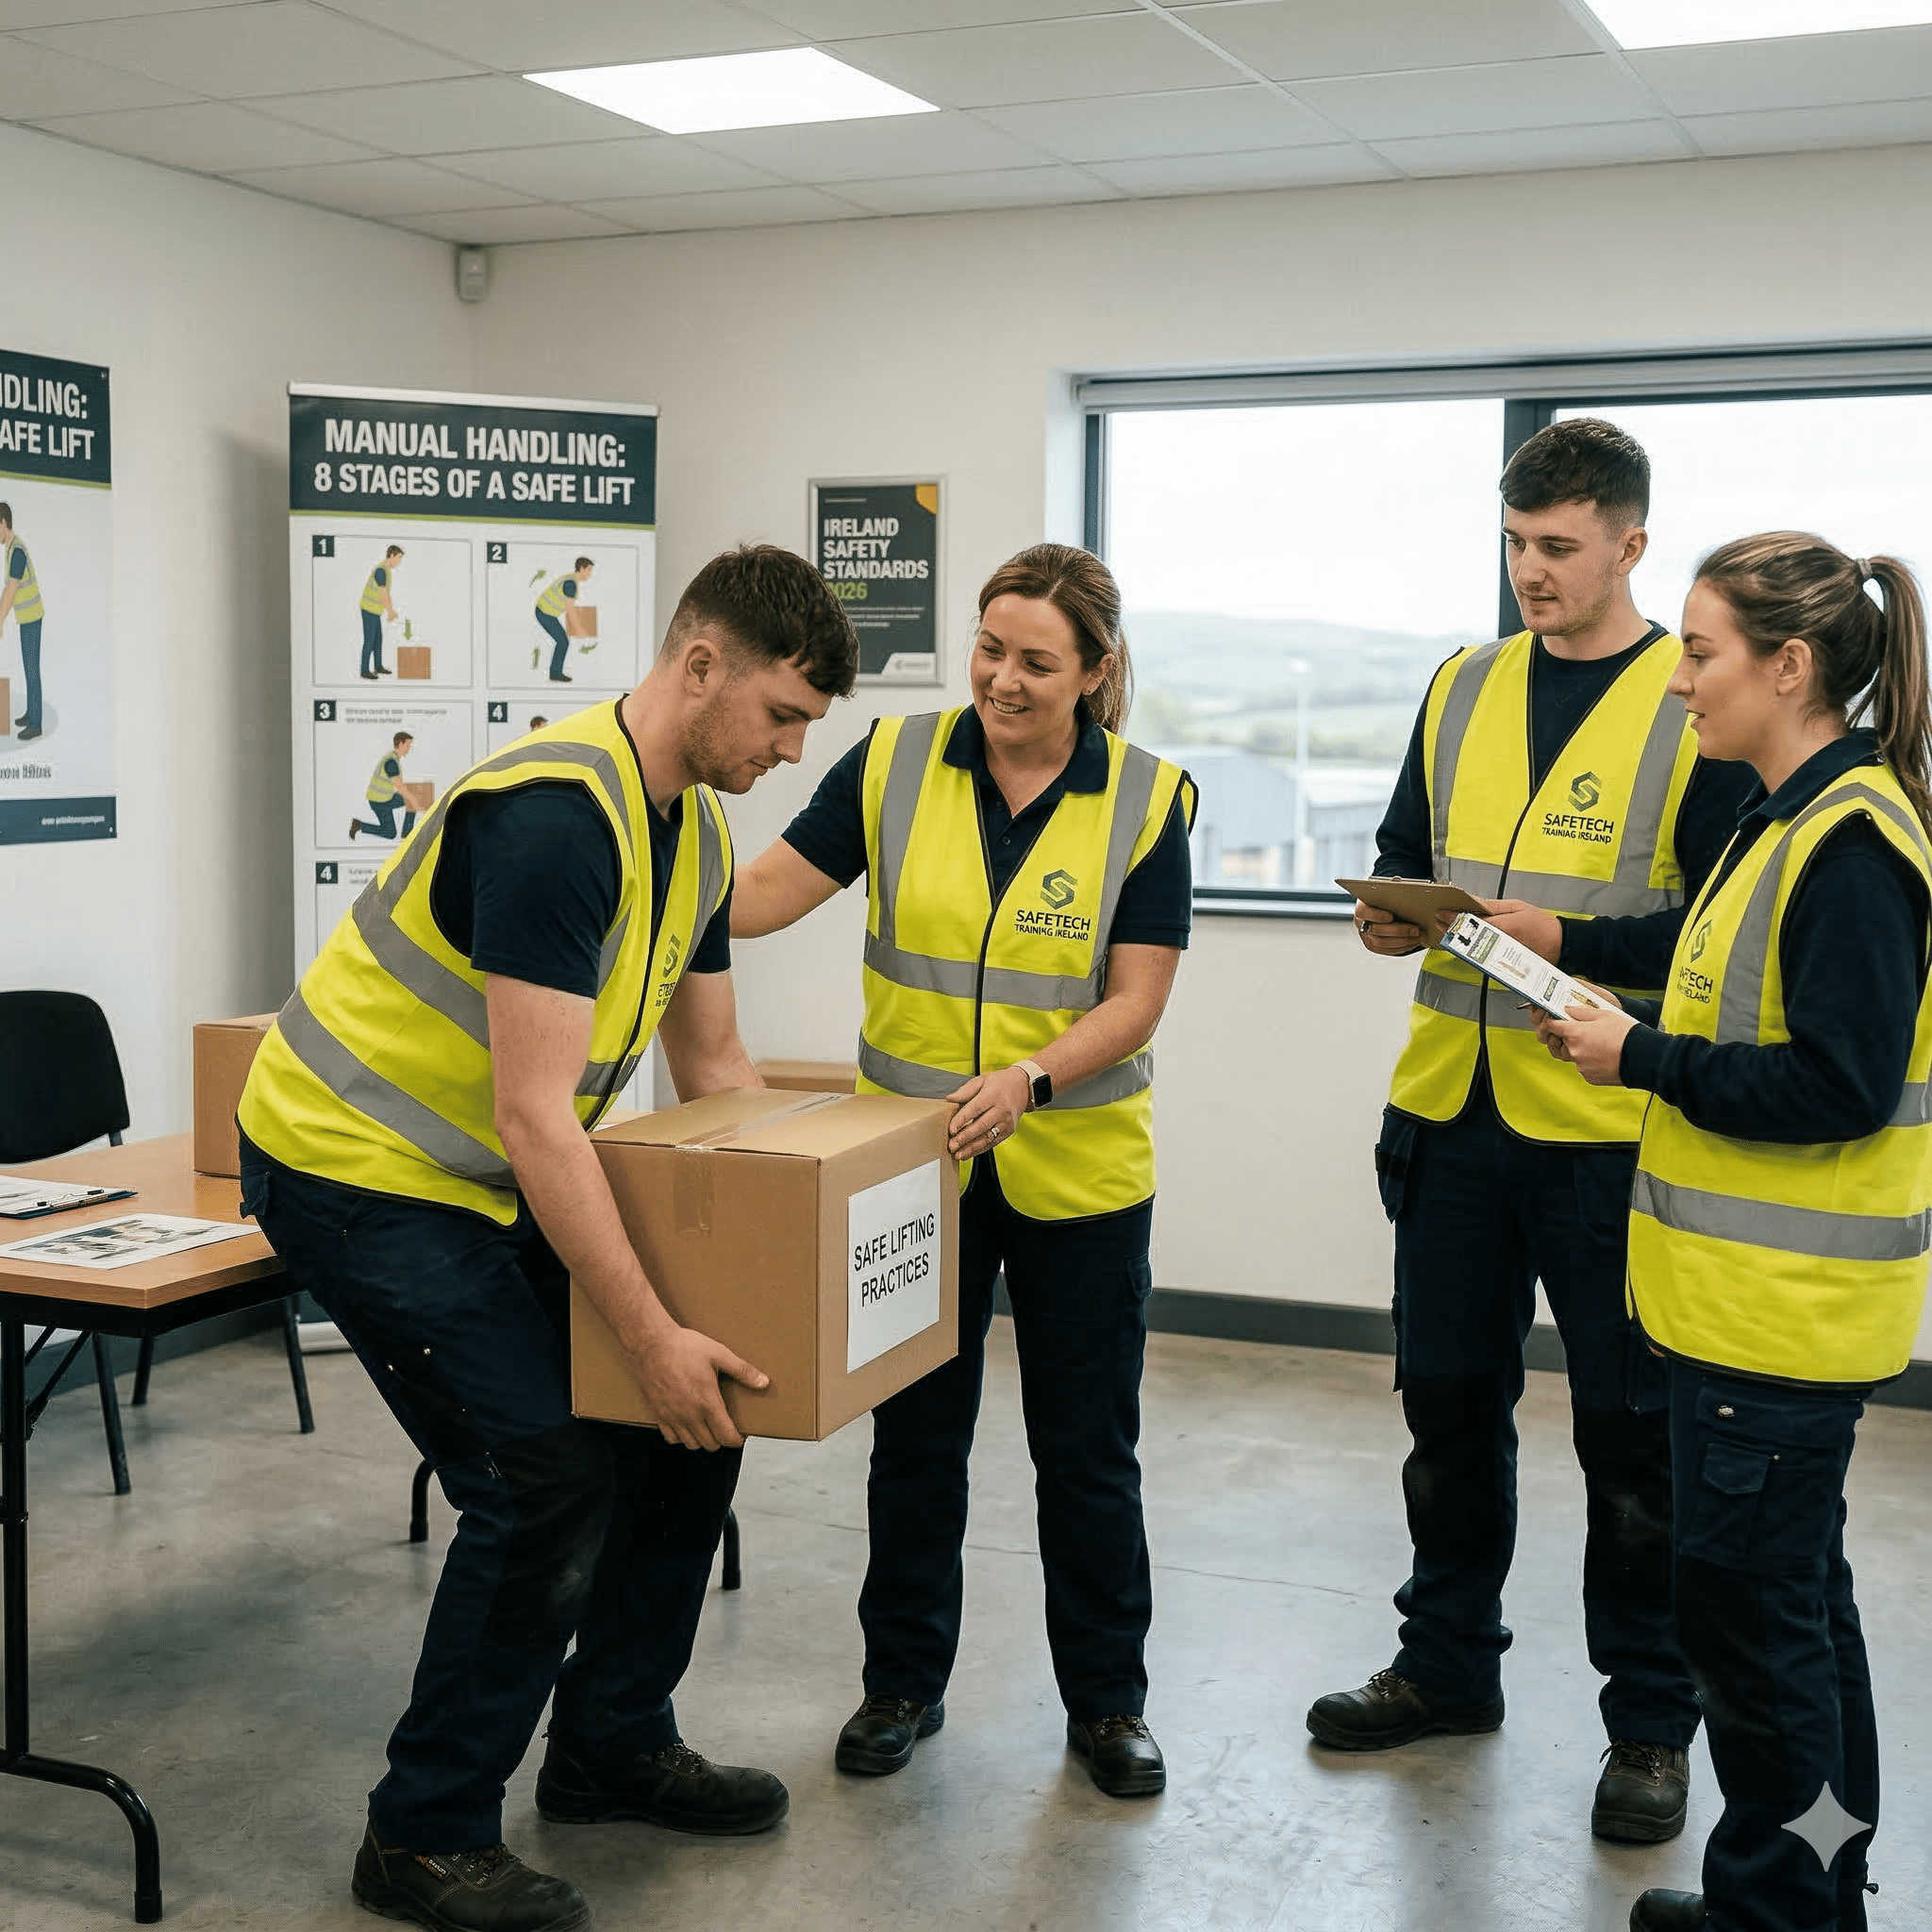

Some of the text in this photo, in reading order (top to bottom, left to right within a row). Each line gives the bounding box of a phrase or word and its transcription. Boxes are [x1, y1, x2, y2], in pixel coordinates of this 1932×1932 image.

[0, 373, 88, 420] DLING:
[48, 425, 95, 460] LIFT
[325, 418, 626, 468] MANUAL HANDLING:
[313, 461, 636, 506] 8 STAGES OF A SAFE LIFT
[823, 517, 900, 538] IRELAND
[318, 538, 327, 555] 1
[491, 543, 503, 561] 2
[823, 539, 891, 559] SAFETY
[823, 559, 930, 580] STANDARDS
[319, 702, 331, 720] 3
[491, 704, 503, 721] 4
[1543, 812, 1615, 834] SAFETECH
[320, 864, 333, 881] 4
[1015, 908, 1091, 931] SAFETECH
[854, 1212, 935, 1273] SAFE LIFTING
[861, 1252, 930, 1308] PRACTICES
